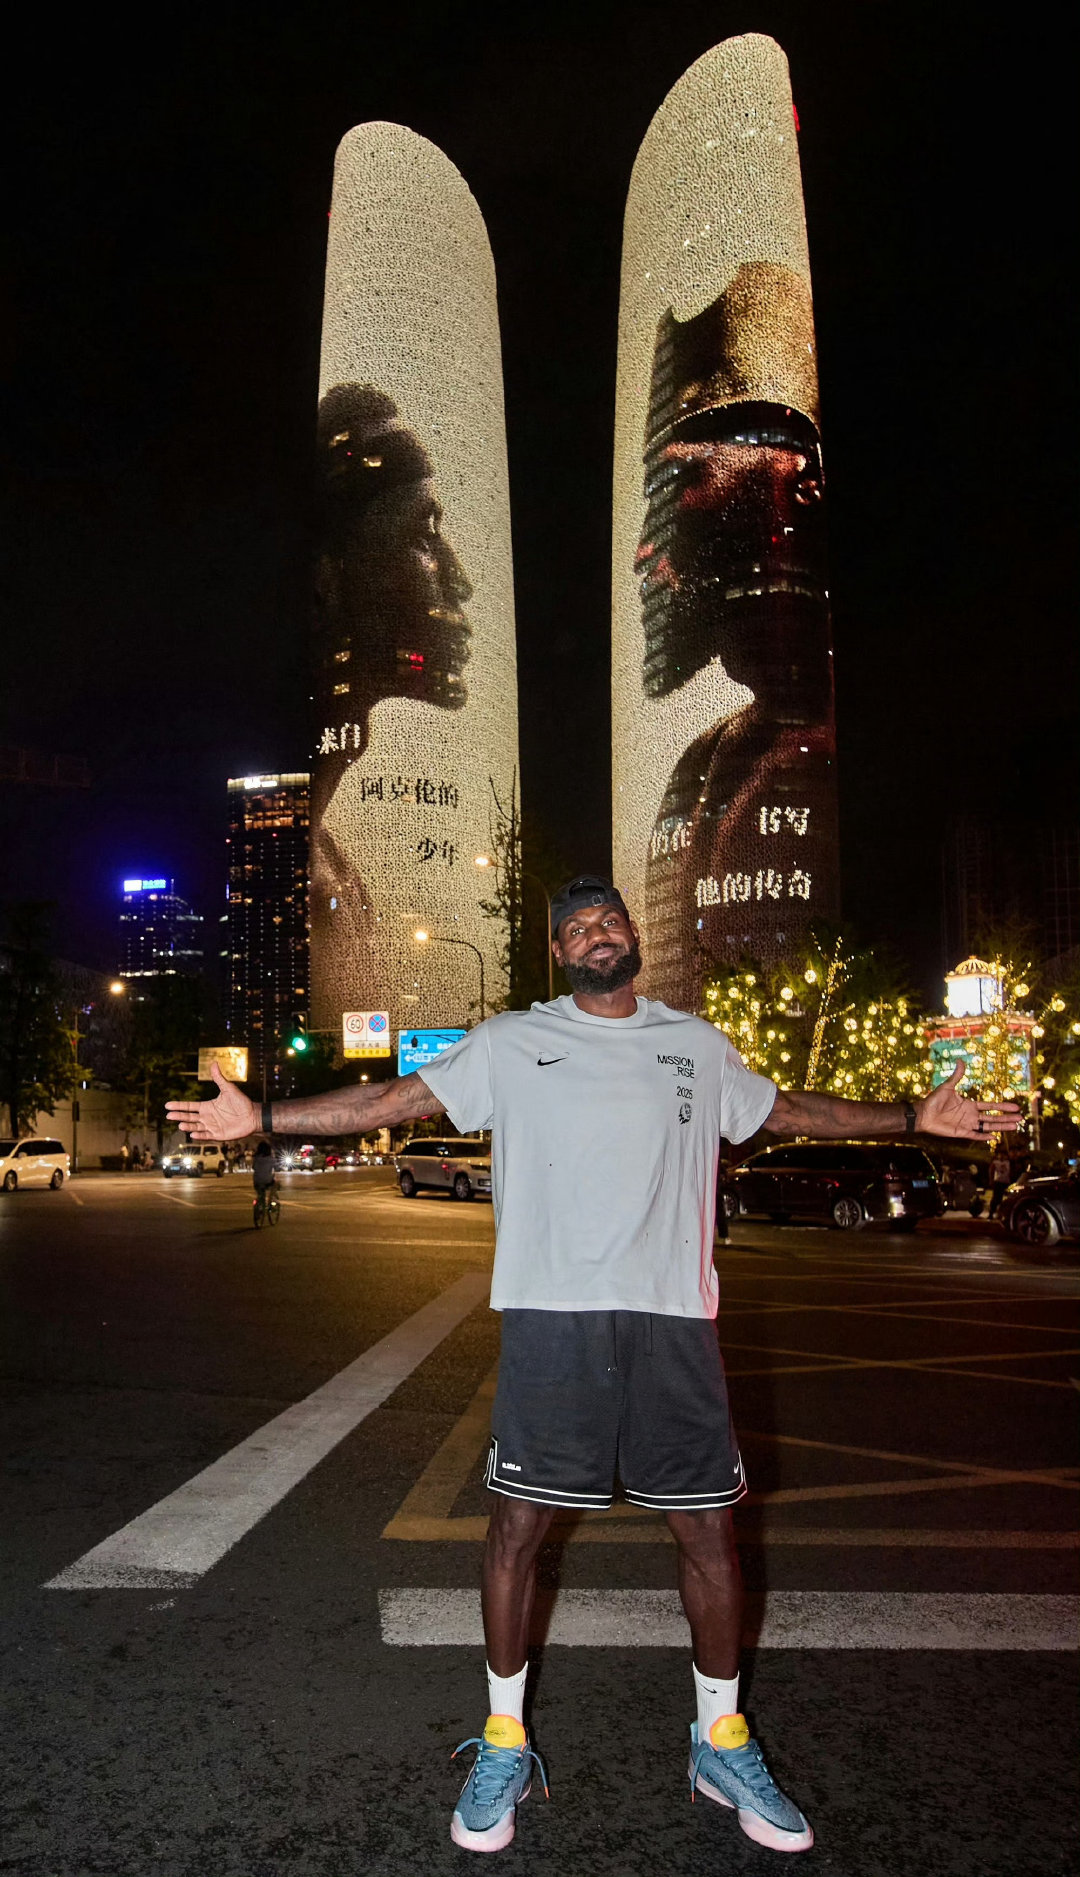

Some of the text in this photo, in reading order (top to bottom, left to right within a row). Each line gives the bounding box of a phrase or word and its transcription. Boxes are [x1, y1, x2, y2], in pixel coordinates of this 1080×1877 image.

[361, 776, 460, 808] 阿克伦的
[417, 838, 460, 866] 少年
[694, 868, 812, 908] 他的传奇
[350, 1018, 361, 1029] 60
[657, 1054, 694, 1068] MISSION
[676, 1085, 693, 1100] 2025
